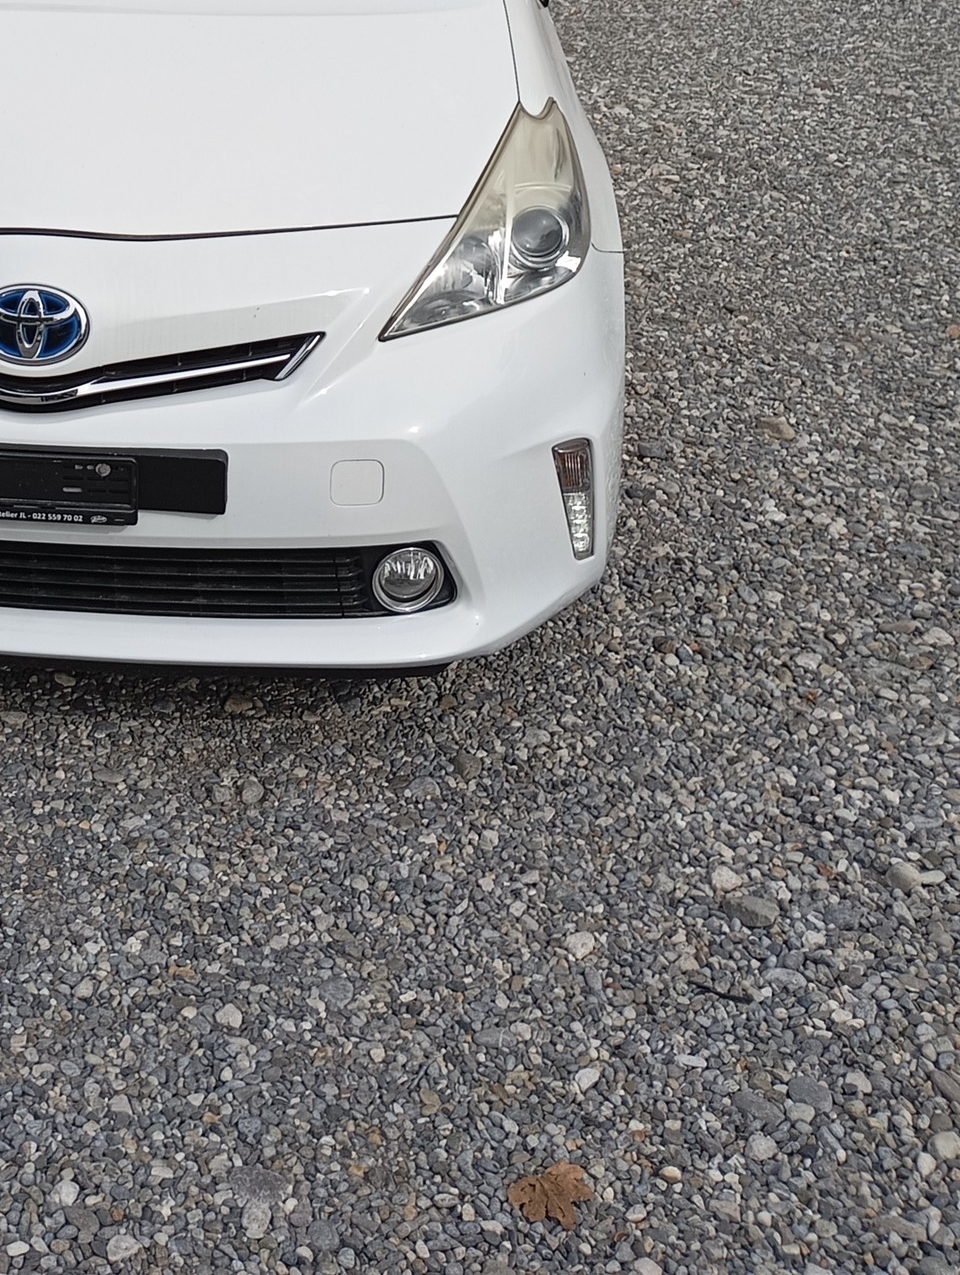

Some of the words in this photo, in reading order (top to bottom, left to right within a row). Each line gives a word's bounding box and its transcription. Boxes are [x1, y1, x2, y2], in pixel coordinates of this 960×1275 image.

[32, 512, 46, 520] 022
[47, 513, 61, 521] 559
[62, 514, 72, 522] 70
[73, 514, 83, 522] 02
